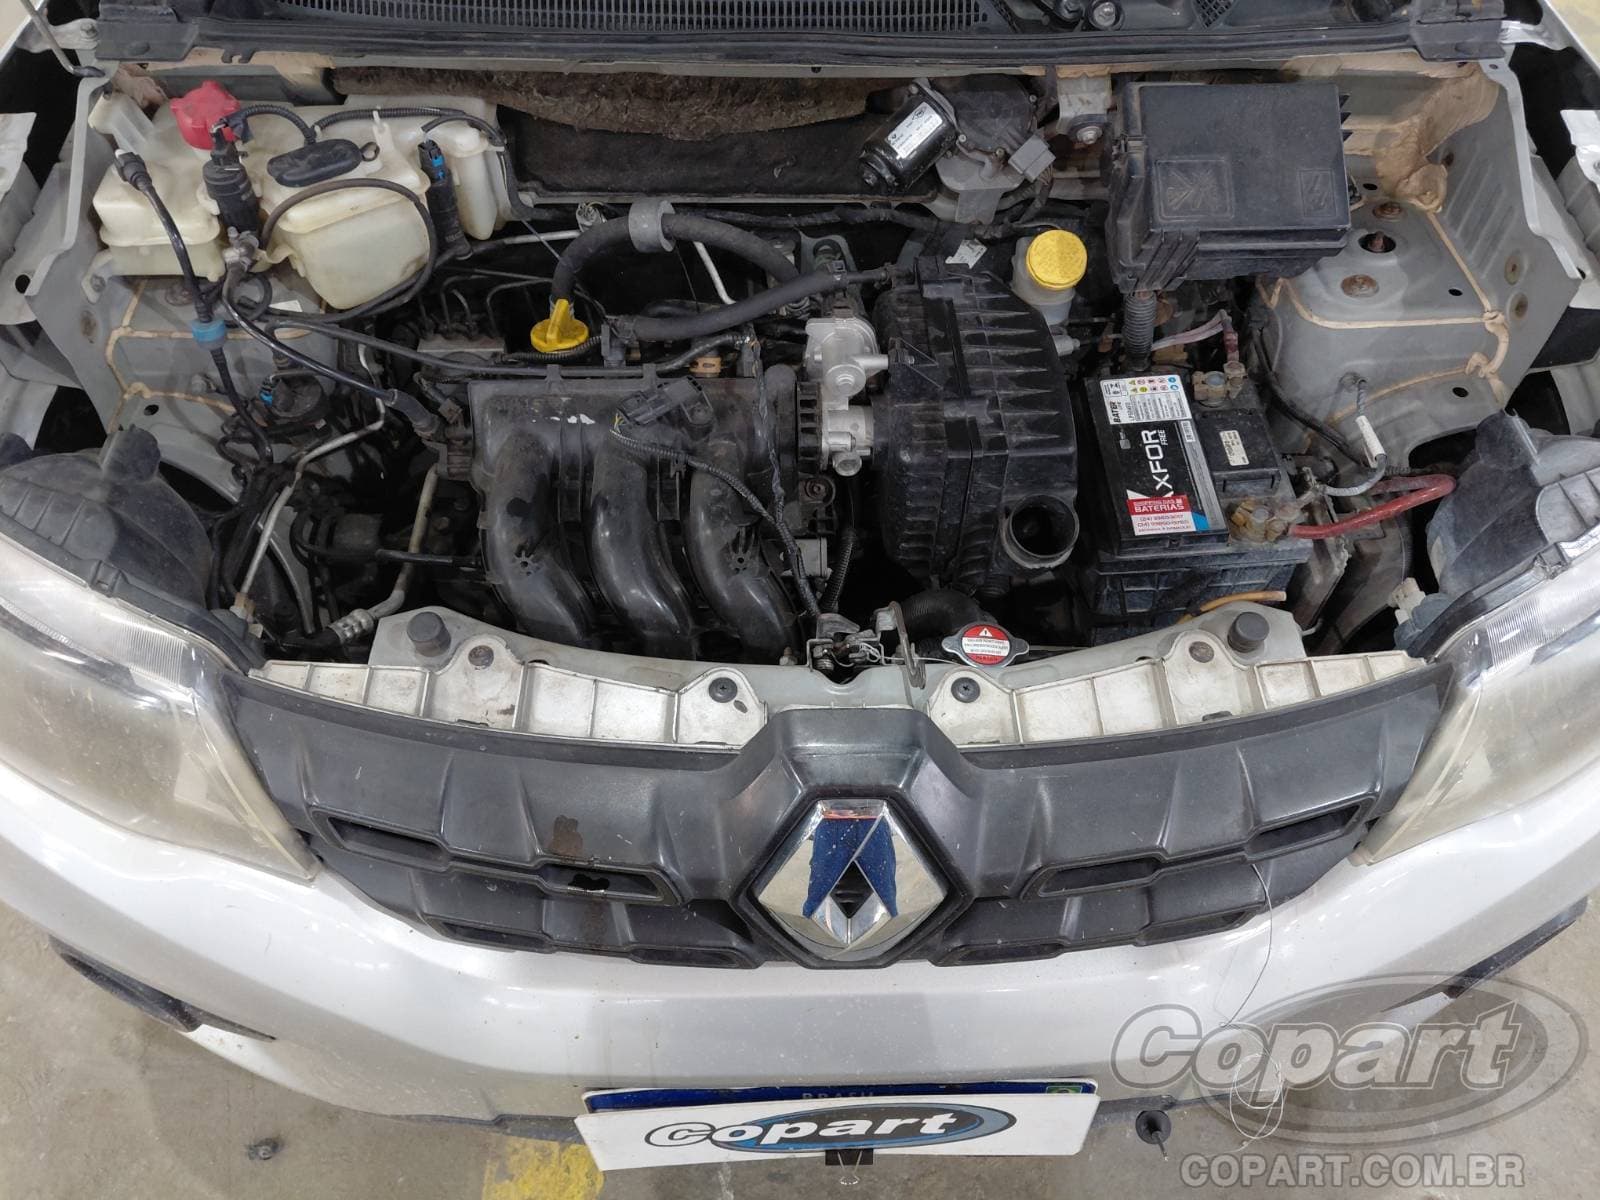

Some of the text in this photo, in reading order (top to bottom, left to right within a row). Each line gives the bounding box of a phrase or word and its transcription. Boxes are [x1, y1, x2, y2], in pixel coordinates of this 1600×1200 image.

[1158, 429, 1168, 446] FREE
[1134, 503, 1185, 513] BATERIAS
[646, 1111, 959, 1147] Copart
